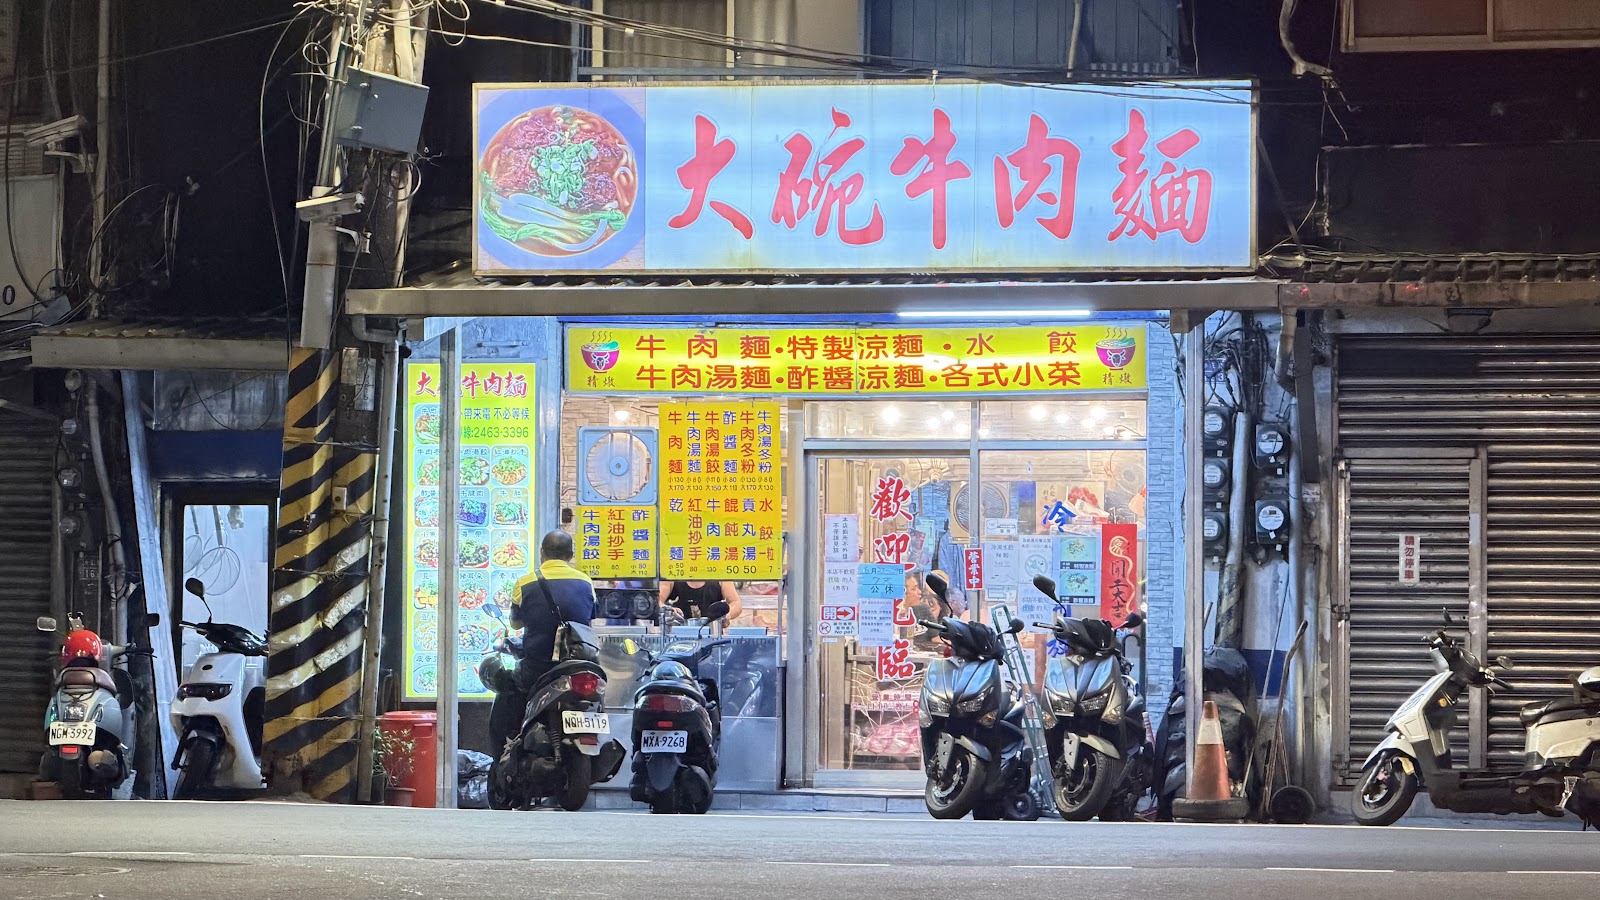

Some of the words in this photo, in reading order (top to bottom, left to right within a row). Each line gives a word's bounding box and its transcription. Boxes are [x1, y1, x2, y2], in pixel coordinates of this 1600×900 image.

[668, 107, 1213, 250] 大碗牛肉麵
[415, 370, 527, 398] 大牛肉麵
[493, 407, 530, 421] 不必等候
[668, 411, 683, 474] 牛肉麵
[686, 411, 701, 474] 牛肉湯麵
[705, 411, 719, 474] 牛肉湯餃
[723, 411, 737, 474] 酢醬麵
[740, 411, 755, 474] 牛肉冬粉
[757, 410, 772, 474] 牛肉湯冬粉
[583, 509, 600, 560] 牛肉湯餃
[607, 509, 625, 560] 紅油抄手
[632, 510, 649, 560] 酢醬麵
[669, 498, 684, 561] 乾麵
[688, 498, 703, 561] 紅油抄手
[706, 498, 720, 561] 牛肉湯
[724, 498, 738, 561] 餛飩湯
[742, 498, 756, 561] 貢丸湯
[759, 498, 773, 540] 水餃
[726, 565, 739, 574] 50
[743, 566, 757, 574] 50
[968, 551, 980, 588] 營業中
[1404, 535, 1414, 579] 請勿停車
[870, 585, 894, 594] 公休
[1109, 560, 1128, 618] 開工大吉
[51, 728, 94, 740] NGM-3992
[565, 717, 607, 729] NQH-5119
[643, 736, 685, 748] MXA-9268
